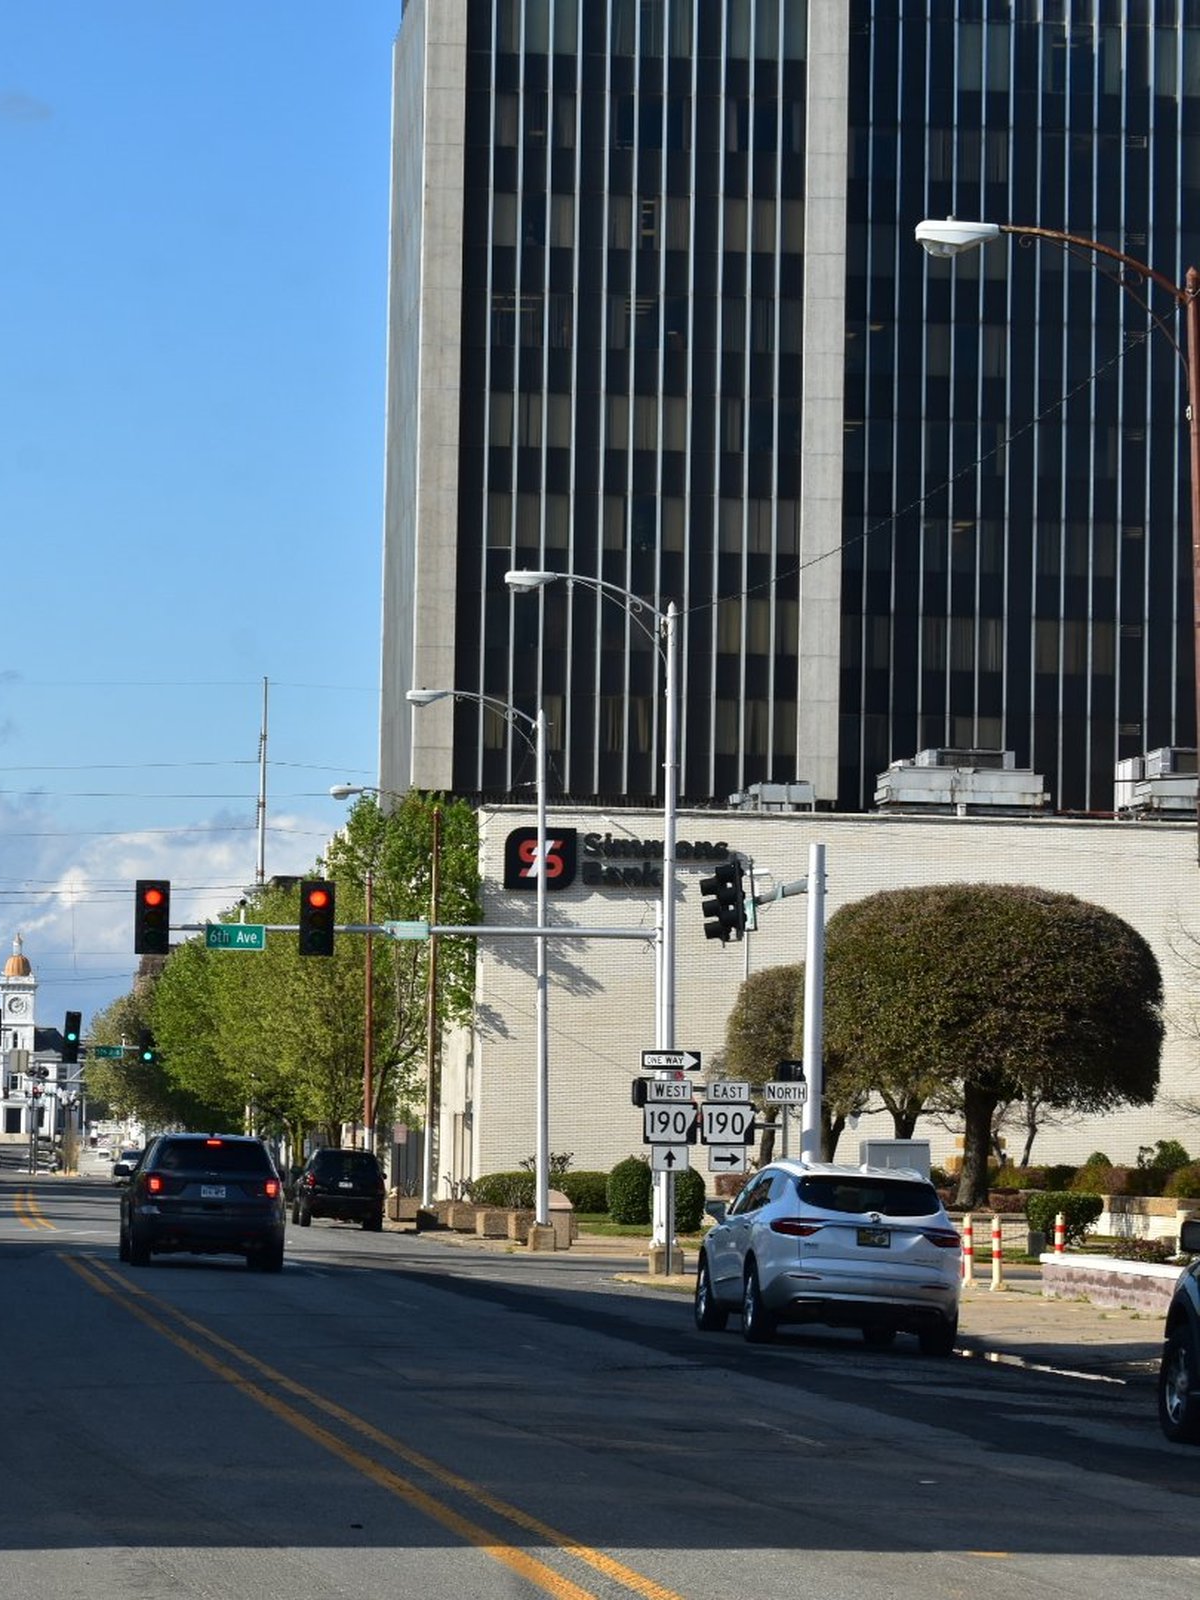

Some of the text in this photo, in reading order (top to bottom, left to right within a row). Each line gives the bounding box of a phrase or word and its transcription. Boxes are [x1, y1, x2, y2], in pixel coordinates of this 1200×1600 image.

[583, 832, 729, 859] Simmons
[582, 861, 662, 887] Bank
[209, 929, 258, 943] 6th Ave
[647, 1055, 684, 1065] ONE WAY
[654, 1083, 688, 1098] WEST
[713, 1084, 744, 1099] EAST
[767, 1085, 806, 1099] NORTH
[649, 1110, 687, 1135] 190
[707, 1111, 745, 1136] 190
